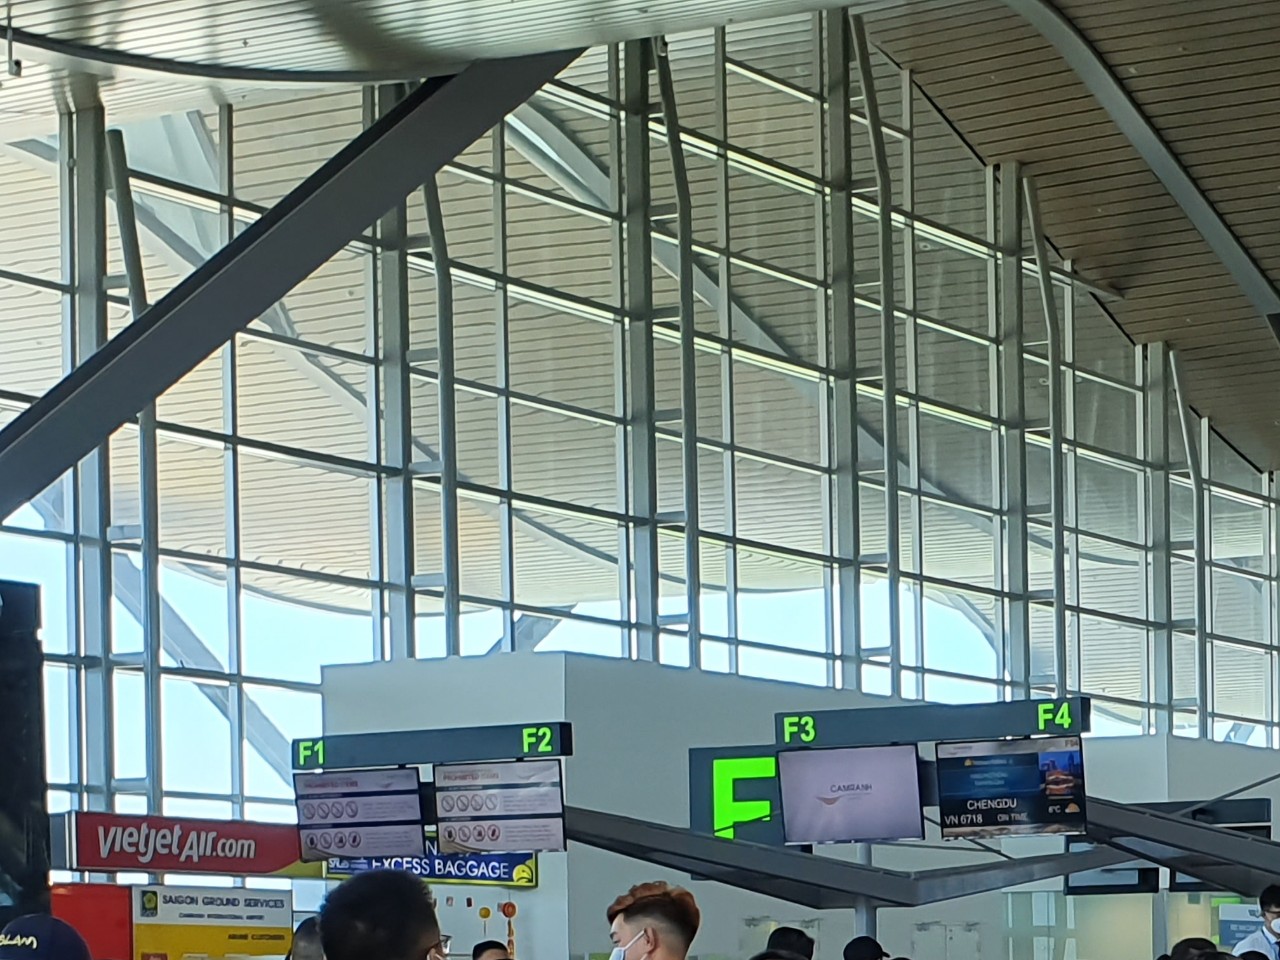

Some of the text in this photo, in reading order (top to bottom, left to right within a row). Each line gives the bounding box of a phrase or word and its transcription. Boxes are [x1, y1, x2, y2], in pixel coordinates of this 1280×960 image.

[1037, 701, 1072, 730] F4
[522, 727, 552, 753] F2
[782, 716, 816, 744] F3
[299, 739, 325, 765] F1
[713, 757, 776, 840] F
[829, 782, 873, 794] CAMRANH
[967, 798, 1017, 810] CHENGDU
[944, 815, 959, 825] VN
[960, 813, 983, 824] 6718
[435, 859, 509, 879] BAGGAGE
[162, 894, 285, 909] SAIGON GROUND SERVICES
